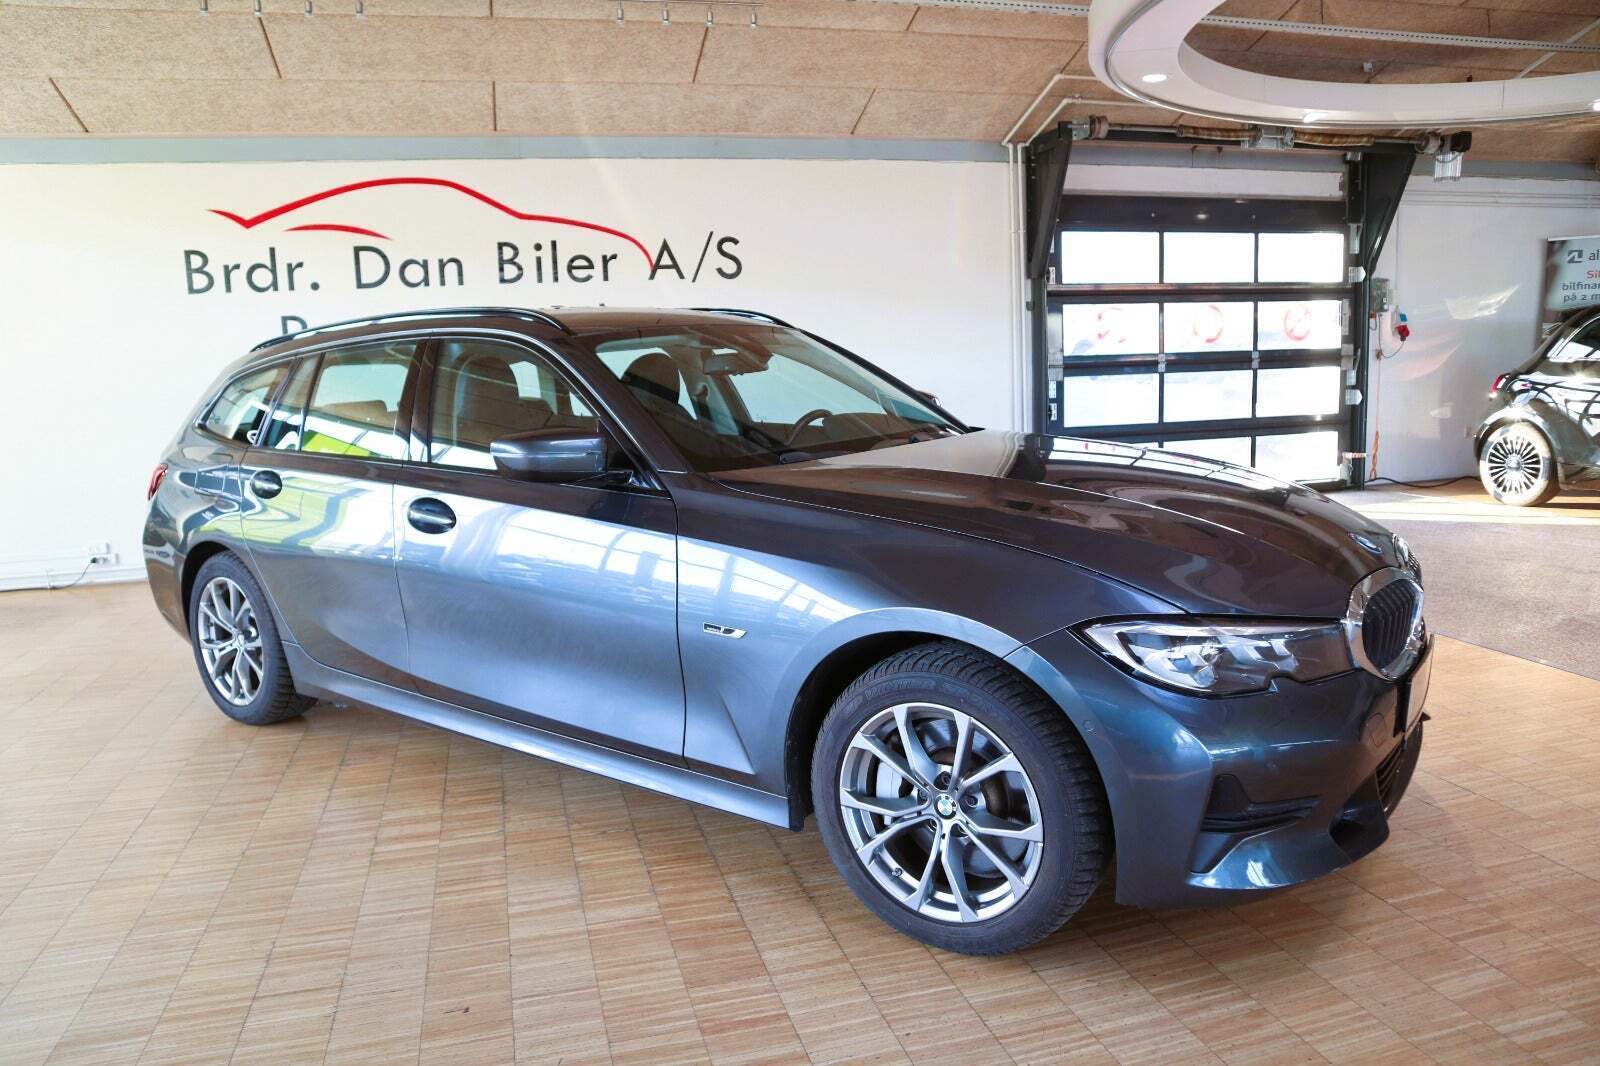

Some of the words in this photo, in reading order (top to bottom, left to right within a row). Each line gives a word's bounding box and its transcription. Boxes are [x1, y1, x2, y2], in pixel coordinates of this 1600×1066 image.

[184, 246, 320, 295] Brdr.
[353, 245, 465, 290] Dan
[497, 240, 618, 284] Biler
[648, 231, 743, 283] A/S
